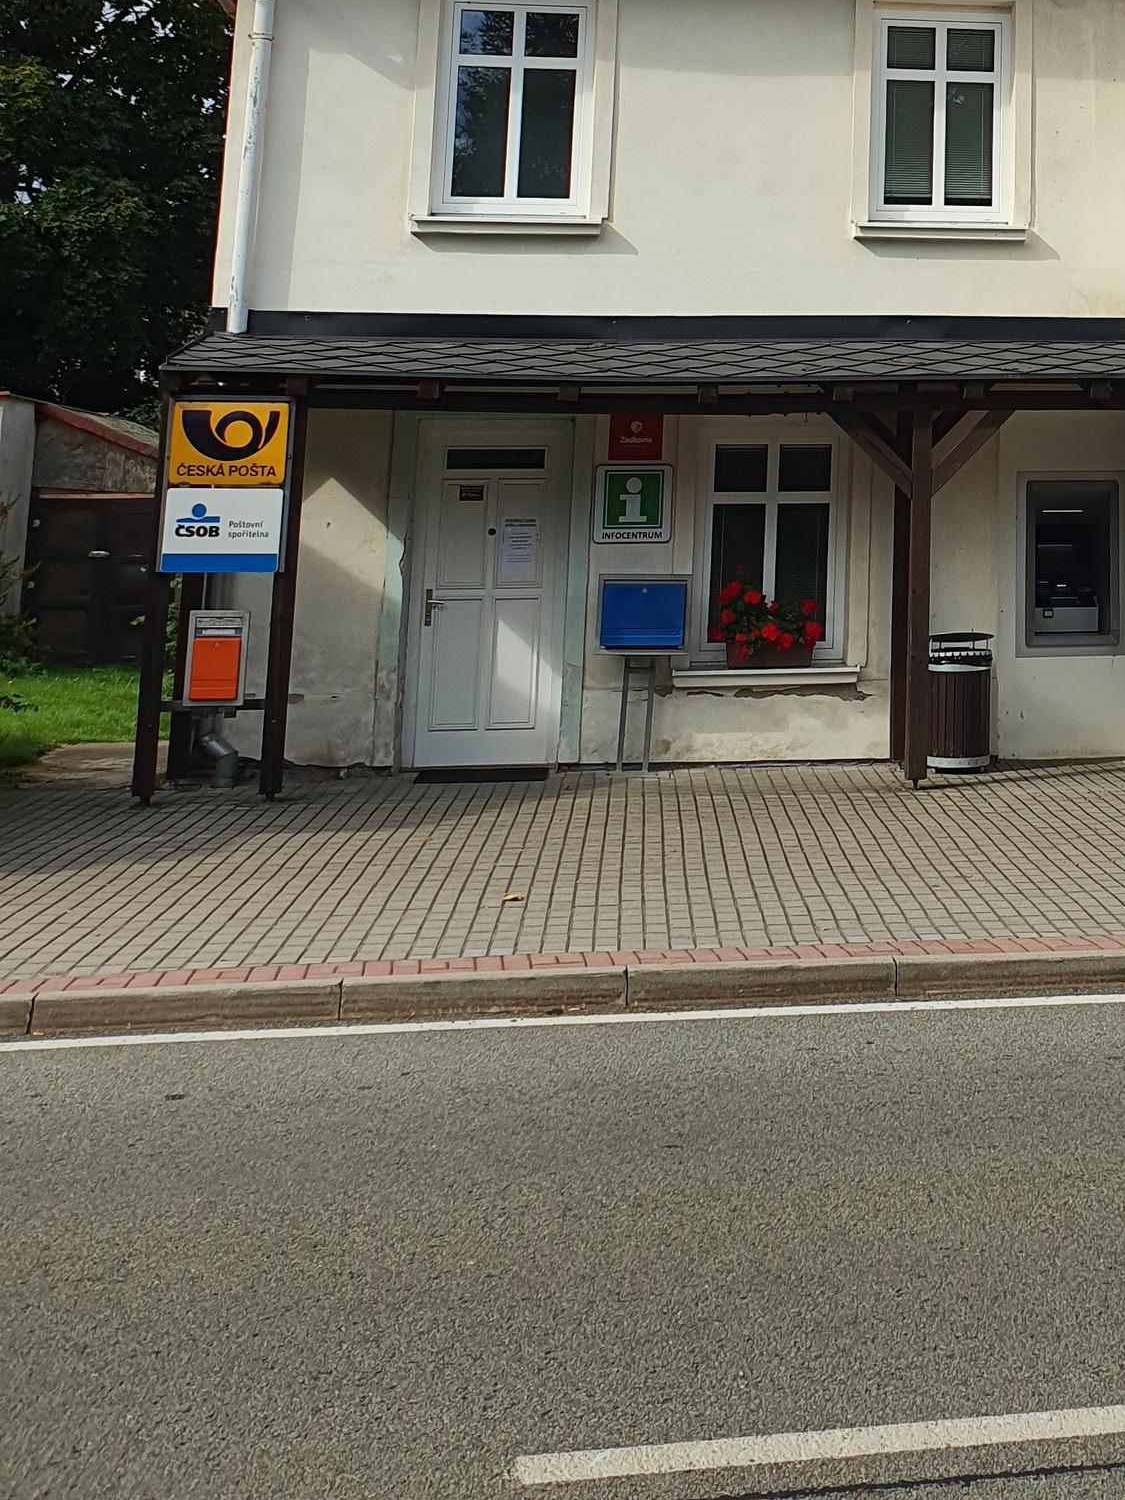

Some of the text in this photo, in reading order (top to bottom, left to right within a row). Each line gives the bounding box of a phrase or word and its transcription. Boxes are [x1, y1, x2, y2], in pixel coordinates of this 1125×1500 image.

[176, 463, 276, 477] ČESKÁ POŠTA
[228, 520, 264, 529] Poštovní
[174, 525, 220, 538] ČSOB
[227, 530, 269, 539] spořitelna
[601, 531, 662, 540] INFOCENTRUM
